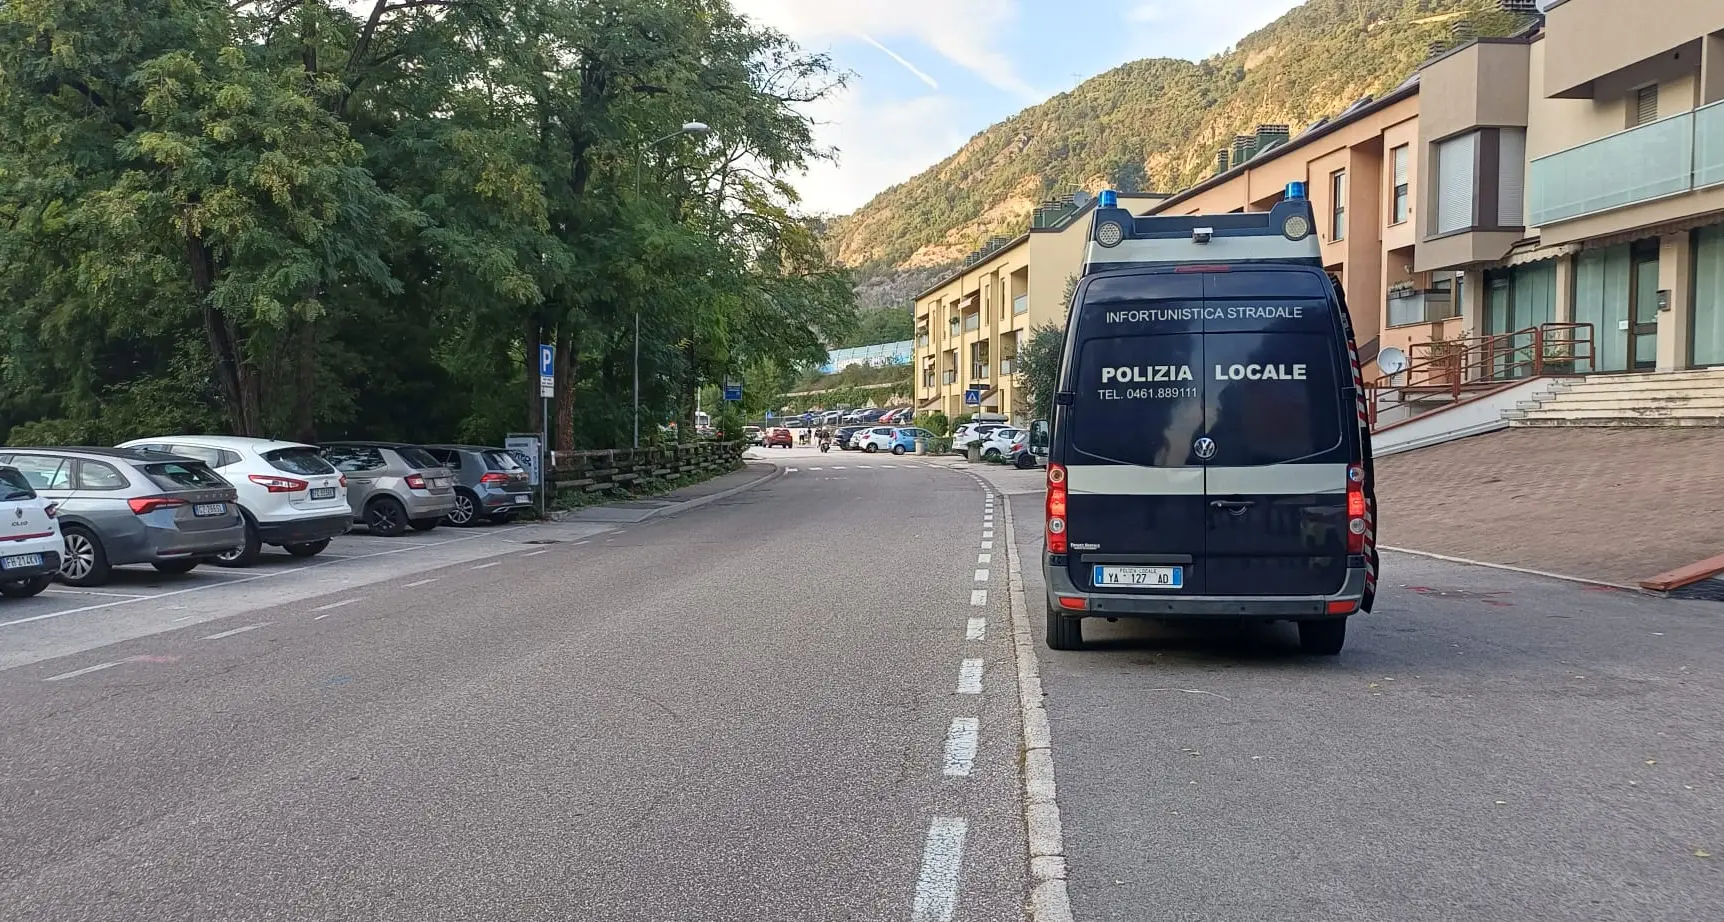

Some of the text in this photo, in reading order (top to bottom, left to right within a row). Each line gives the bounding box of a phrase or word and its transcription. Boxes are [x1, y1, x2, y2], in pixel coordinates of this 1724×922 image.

[1106, 307, 1303, 323] INFORTUNISTICA STRADALE
[543, 349, 551, 372] P
[1102, 364, 1307, 383] POLIZIA LOCALE
[1098, 388, 1197, 400] TEL. 0461.889111
[1108, 573, 1169, 583] YA 127 AD
